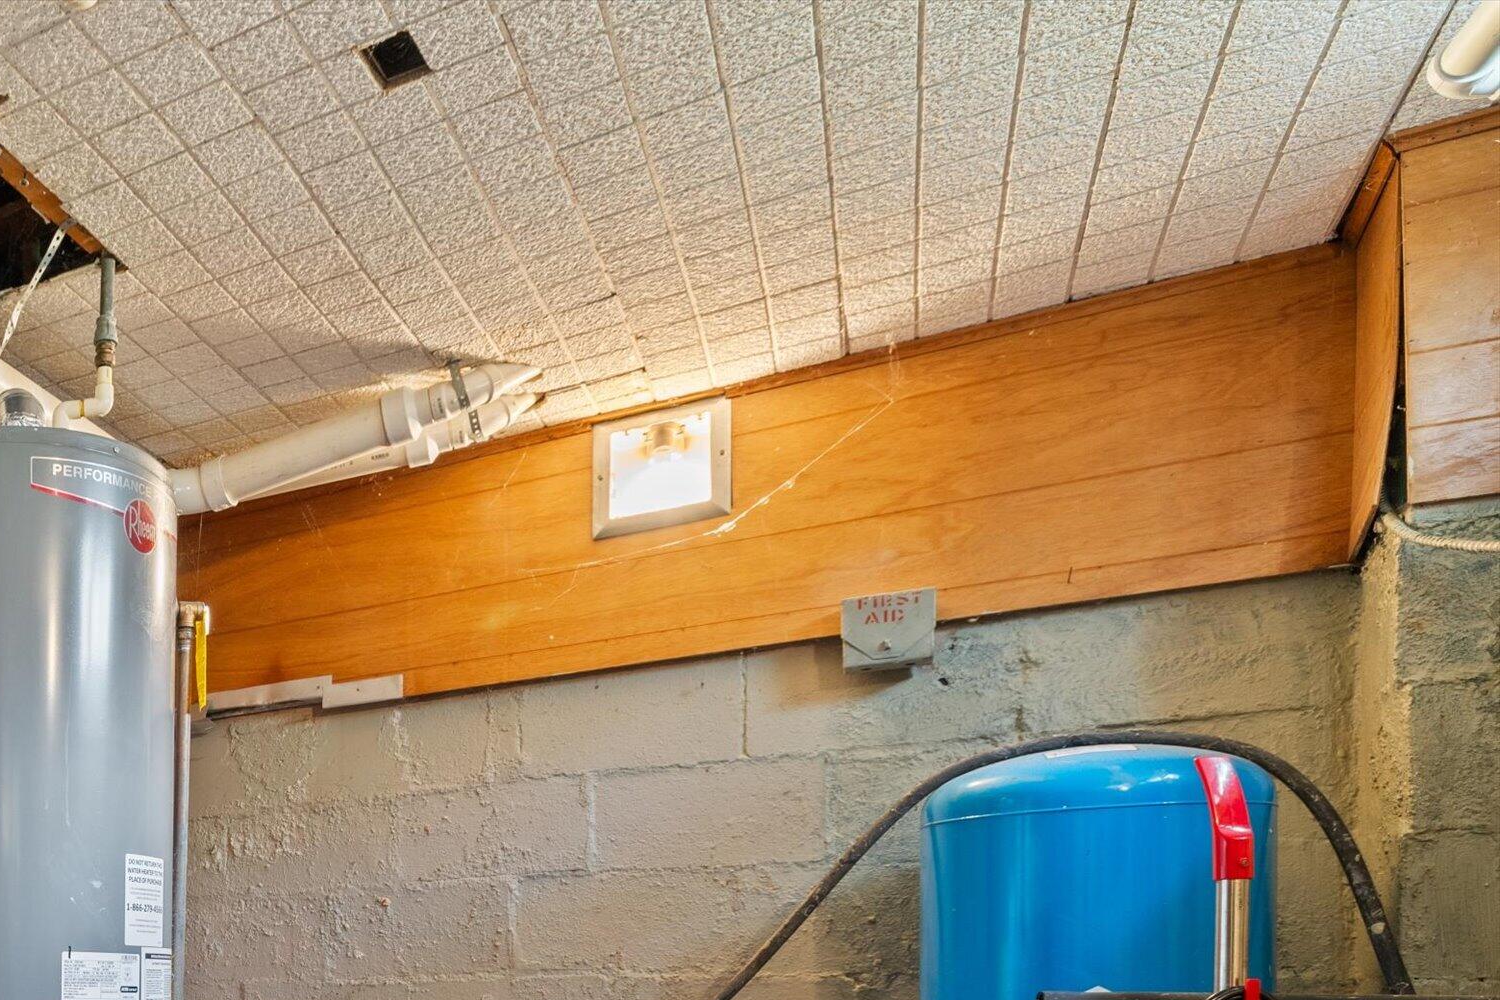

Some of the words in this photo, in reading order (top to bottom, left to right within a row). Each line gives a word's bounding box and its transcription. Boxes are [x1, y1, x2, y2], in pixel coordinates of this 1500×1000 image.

[52, 463, 152, 496] PERFORMANCE
[129, 498, 156, 543] Rheem
[857, 590, 922, 610] FIRST
[864, 609, 904, 625] AID
